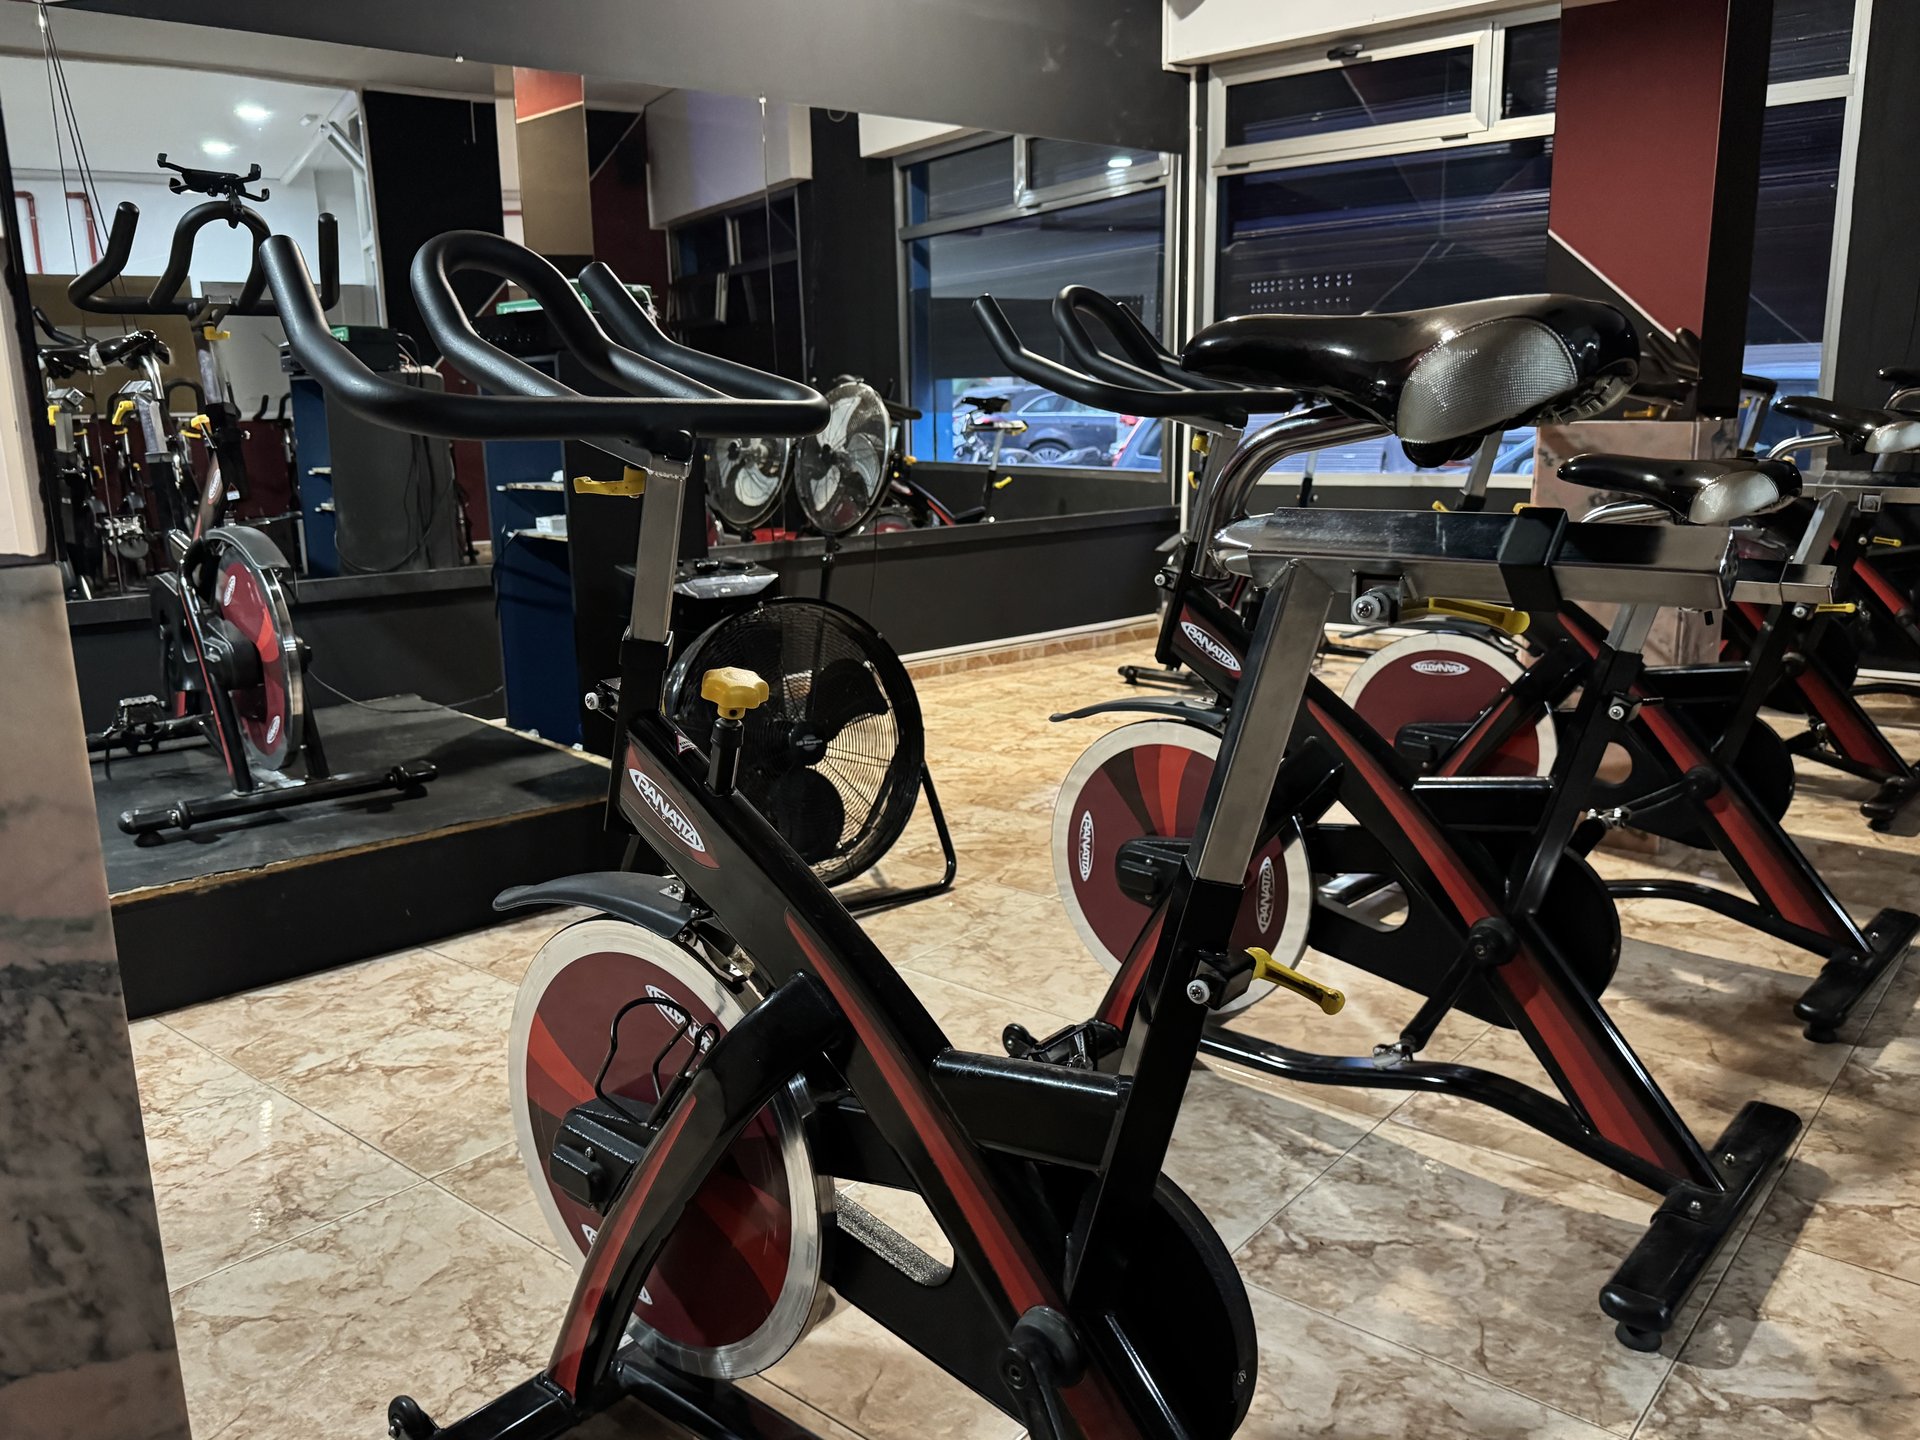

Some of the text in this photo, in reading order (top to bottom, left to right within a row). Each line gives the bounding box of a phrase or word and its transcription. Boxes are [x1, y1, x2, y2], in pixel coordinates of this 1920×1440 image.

[1184, 624, 1237, 669] PANATTA
[634, 773, 700, 848] PANATTA
[1080, 815, 1093, 877] PANATTA
[1259, 862, 1273, 929] PANATTA
